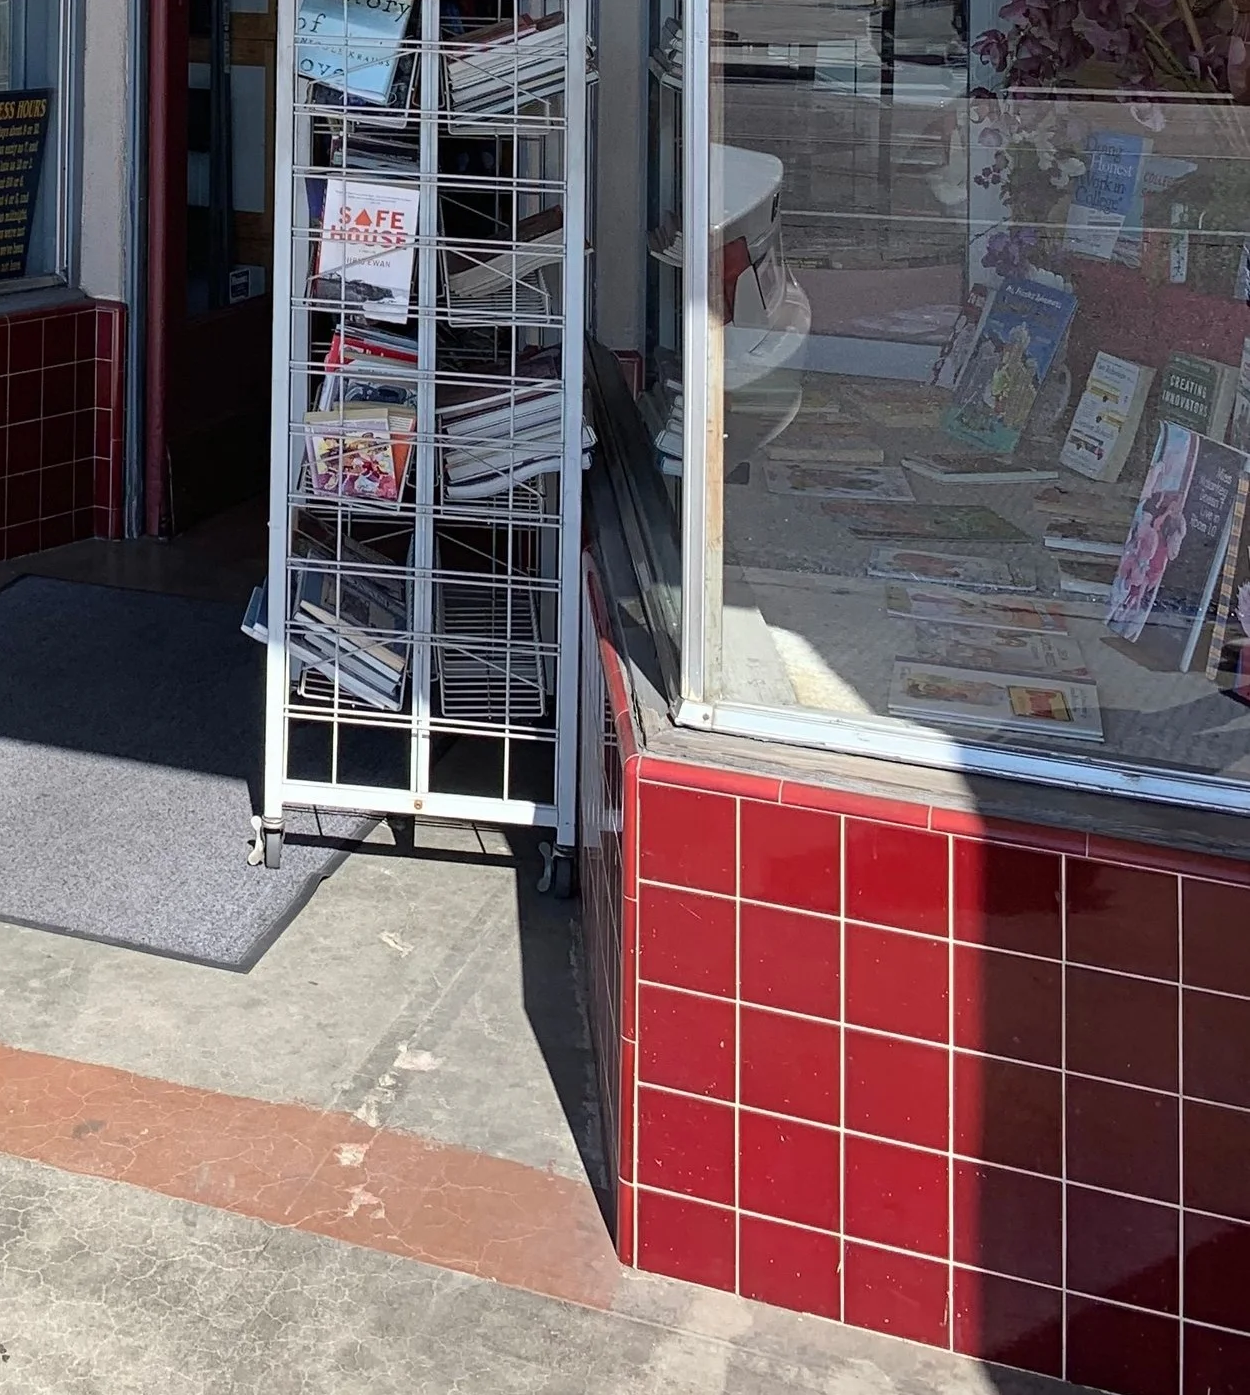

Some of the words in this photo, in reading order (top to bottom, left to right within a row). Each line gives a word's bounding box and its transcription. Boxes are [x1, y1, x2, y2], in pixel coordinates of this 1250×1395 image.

[17, 99, 47, 119] HOURS
[1091, 154, 1133, 177] Honest
[367, 259, 391, 268] EWAN
[1170, 374, 1208, 400] CREATING
[1161, 389, 1209, 418] INNOVATORS
